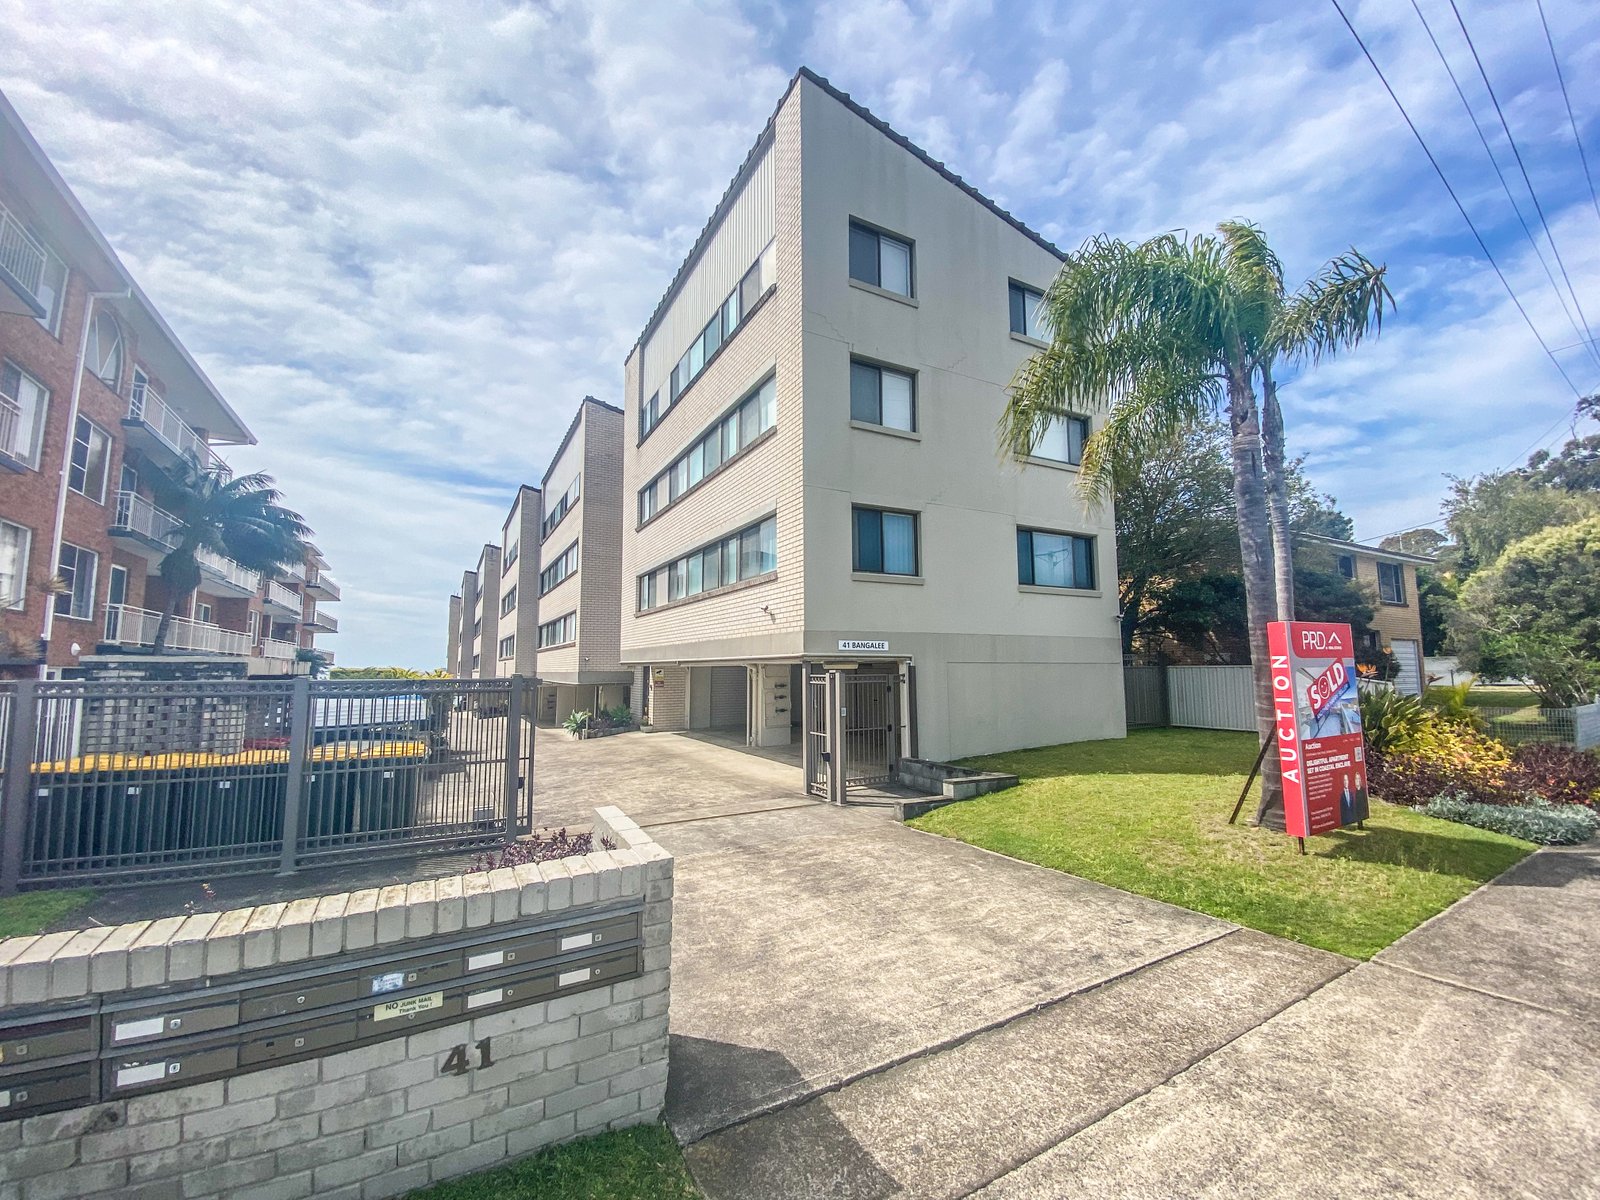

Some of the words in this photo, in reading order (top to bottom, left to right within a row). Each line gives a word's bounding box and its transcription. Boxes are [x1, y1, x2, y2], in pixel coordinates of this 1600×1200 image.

[1310, 662, 1345, 709] SOLD
[1271, 655, 1300, 784] AUCTION
[1305, 742, 1322, 750] Auction
[385, 1001, 399, 1011] NO
[400, 999, 416, 1008] JUNK
[418, 996, 433, 1004] MAIL
[399, 1006, 416, 1014] Thank
[441, 1036, 496, 1076] 41
